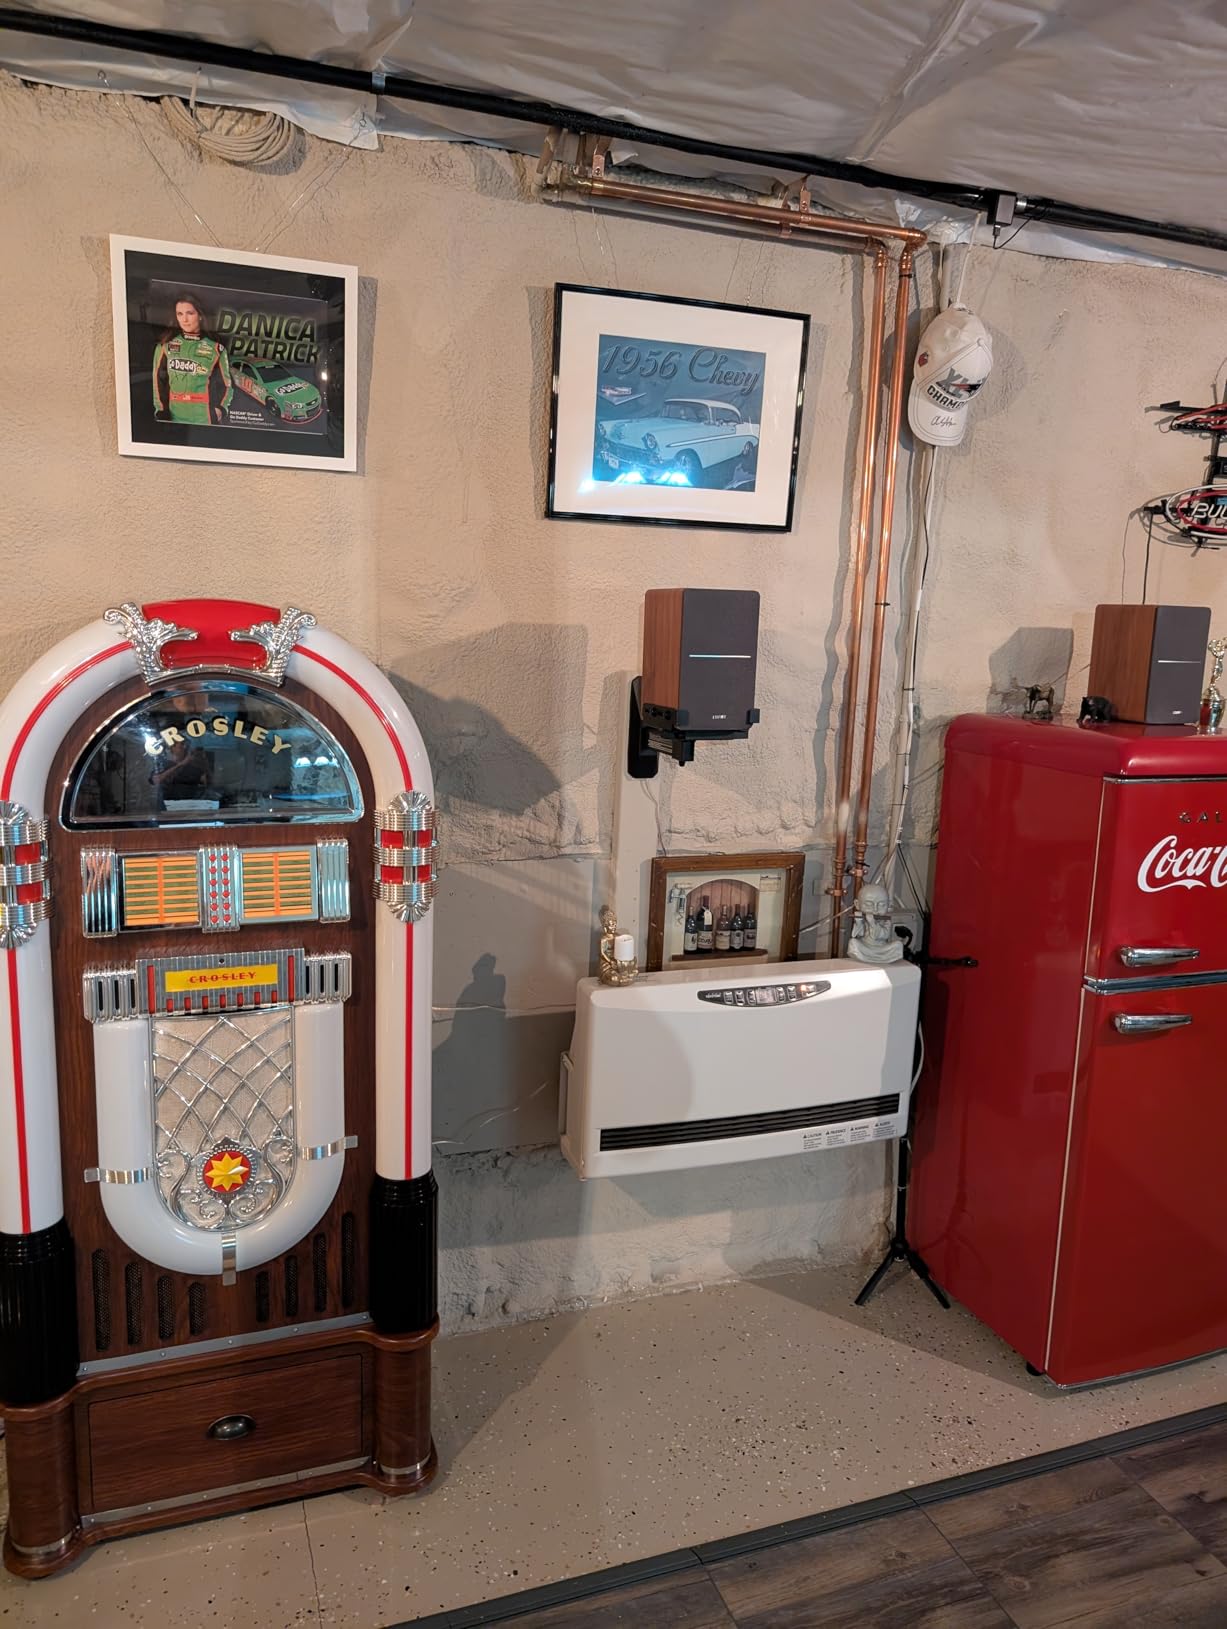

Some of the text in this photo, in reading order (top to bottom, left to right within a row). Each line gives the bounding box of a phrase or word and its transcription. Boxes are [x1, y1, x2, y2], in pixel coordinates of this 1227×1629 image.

[217, 309, 316, 343] DANICA
[229, 336, 320, 364] PATRICK
[602, 344, 760, 396] 1956 Chevy
[144, 716, 292, 756] CROSLEY
